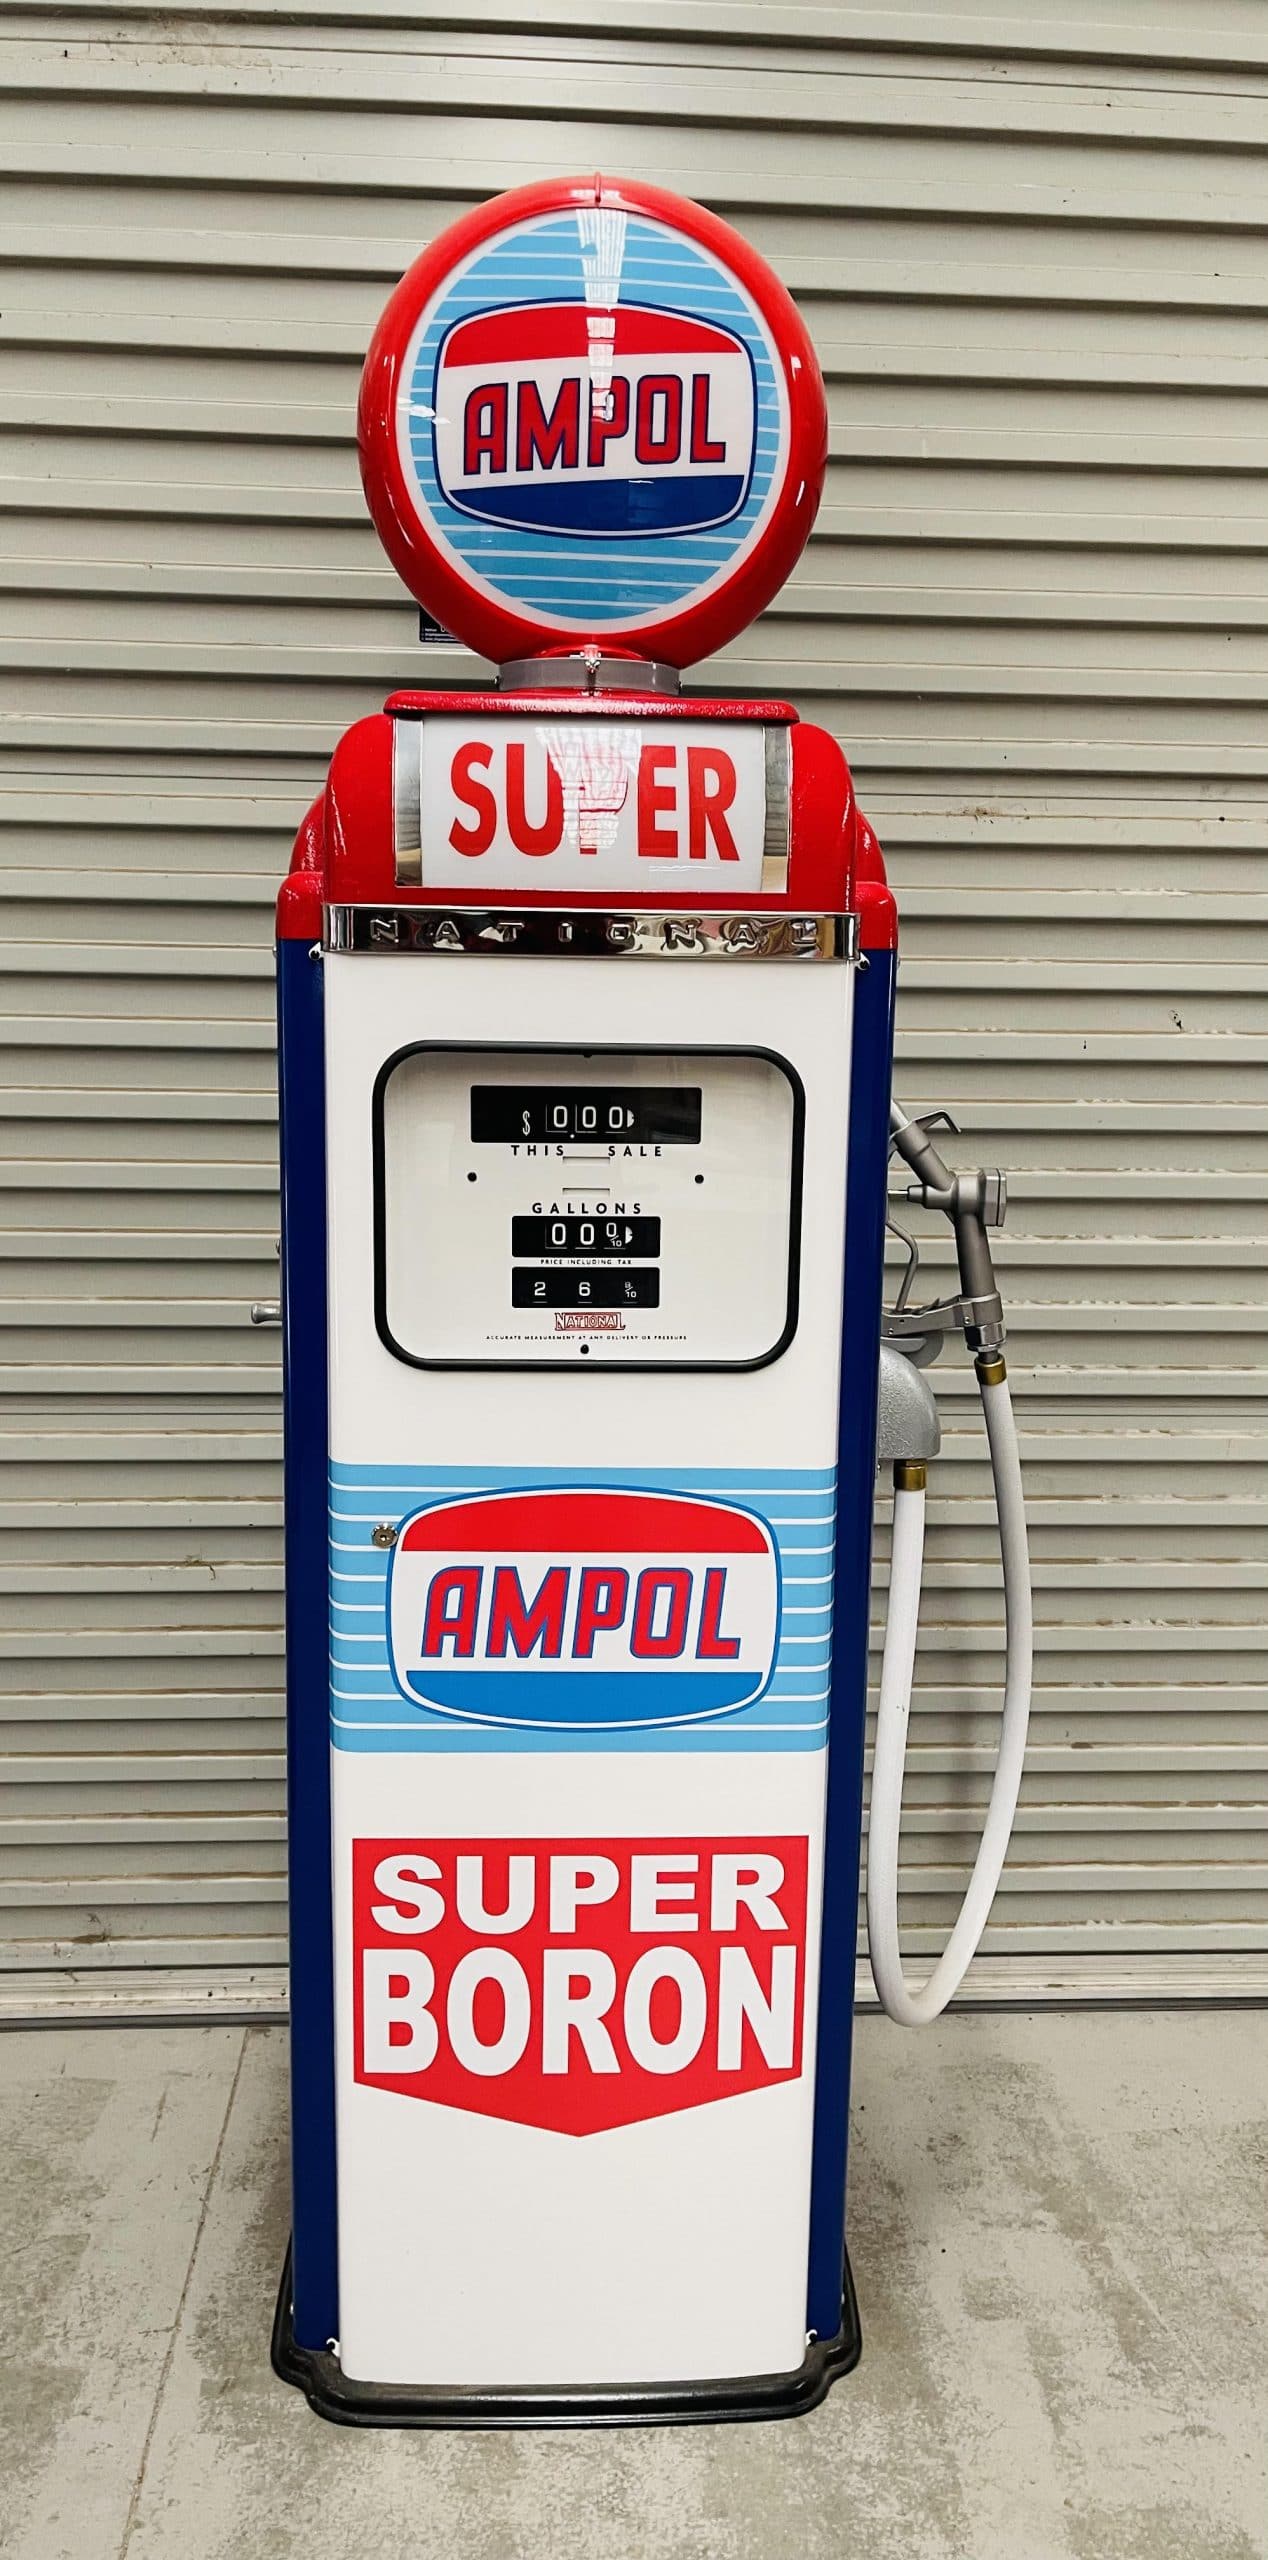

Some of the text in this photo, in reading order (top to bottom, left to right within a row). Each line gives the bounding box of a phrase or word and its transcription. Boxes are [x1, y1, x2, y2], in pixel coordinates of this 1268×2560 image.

[463, 373, 726, 476] AMPOL
[370, 917, 818, 950] NATIONAL
[511, 1145, 662, 1157] THIS SALE
[532, 1202, 641, 1214] GALLONS
[421, 1566, 742, 1659] AMPOL
[371, 1853, 789, 1935] SUPER
[363, 1945, 797, 2075] BORON
